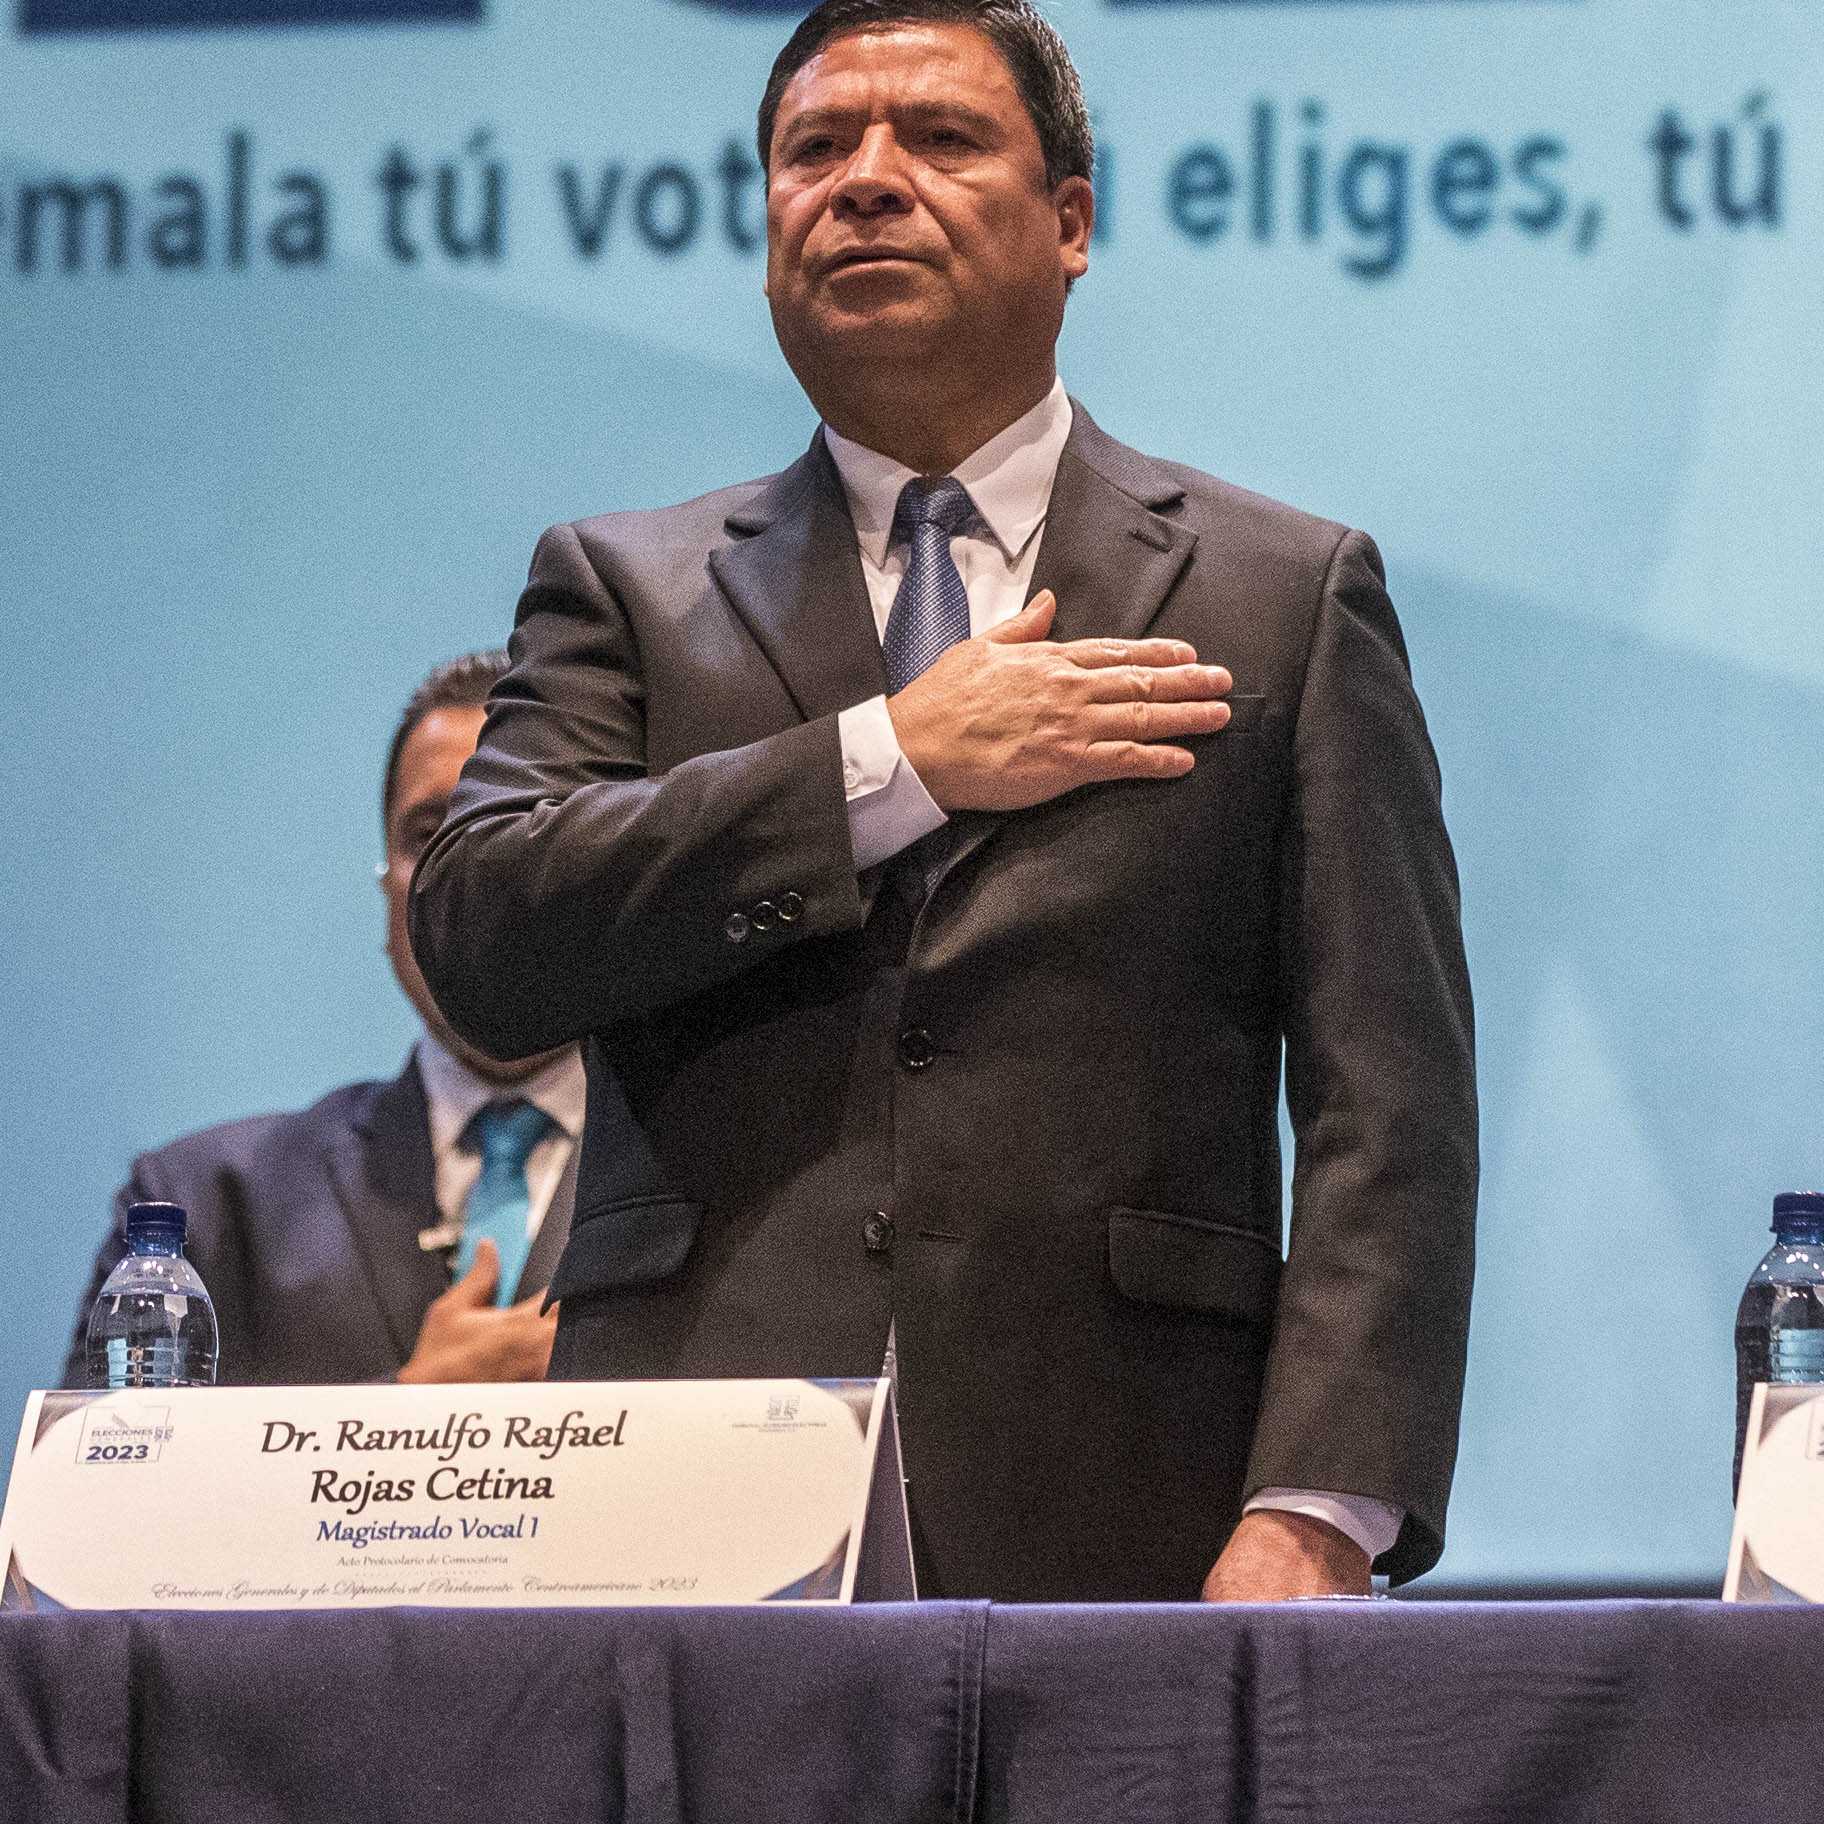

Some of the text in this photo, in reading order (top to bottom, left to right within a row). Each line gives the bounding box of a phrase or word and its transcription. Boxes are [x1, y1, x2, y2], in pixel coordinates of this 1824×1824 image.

[375, 131, 506, 268] tú
[551, 131, 765, 271] vot
[1164, 99, 1602, 285] eliges,
[1646, 94, 1782, 232] tú
[86, 1444, 149, 1461] 2023
[261, 1409, 628, 1462] Dr. Ranulfo Rafael
[310, 1466, 555, 1516] Rojas Cetina
[316, 1517, 453, 1549] Magistrado
[460, 1513, 525, 1539] Vocal
